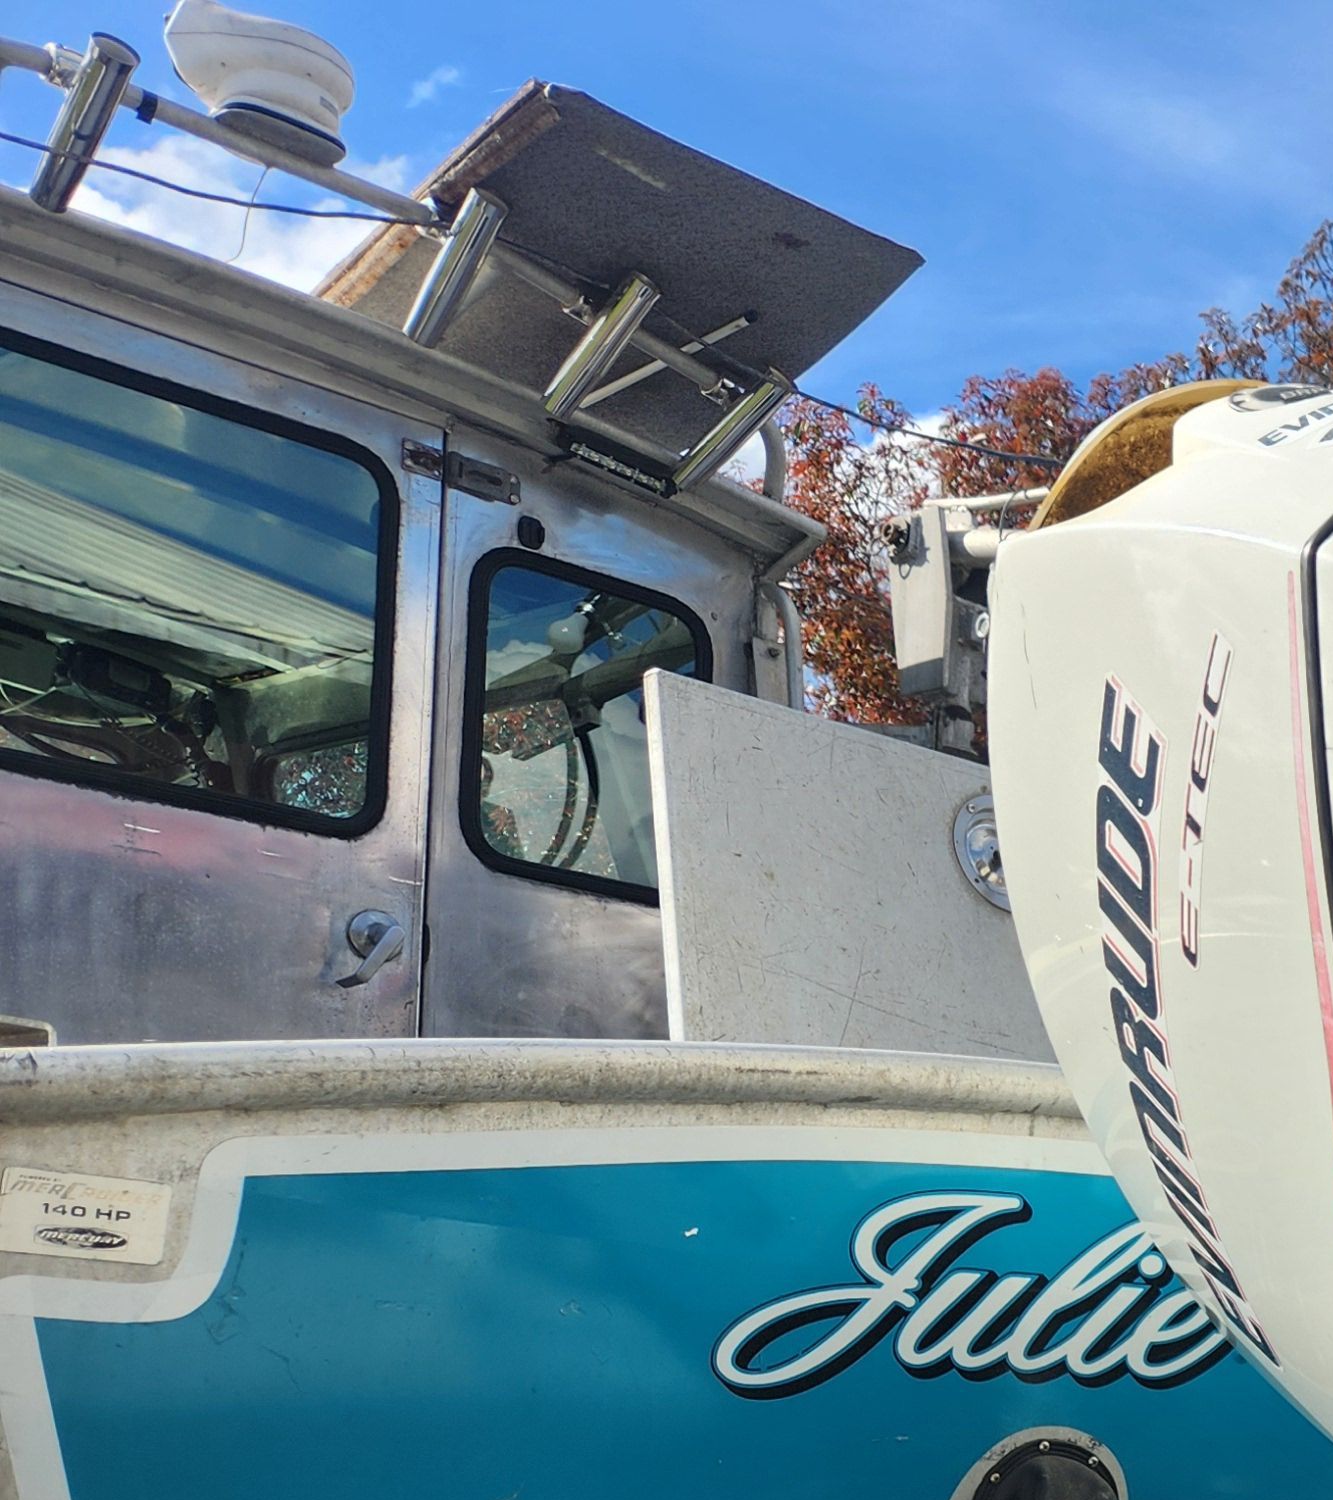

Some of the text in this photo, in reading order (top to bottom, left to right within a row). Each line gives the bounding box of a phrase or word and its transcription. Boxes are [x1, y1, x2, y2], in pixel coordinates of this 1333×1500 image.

[1180, 631, 1233, 969] E-TEC
[42, 1202, 132, 1222] 140 HP
[711, 1189, 1236, 1400] Julie
